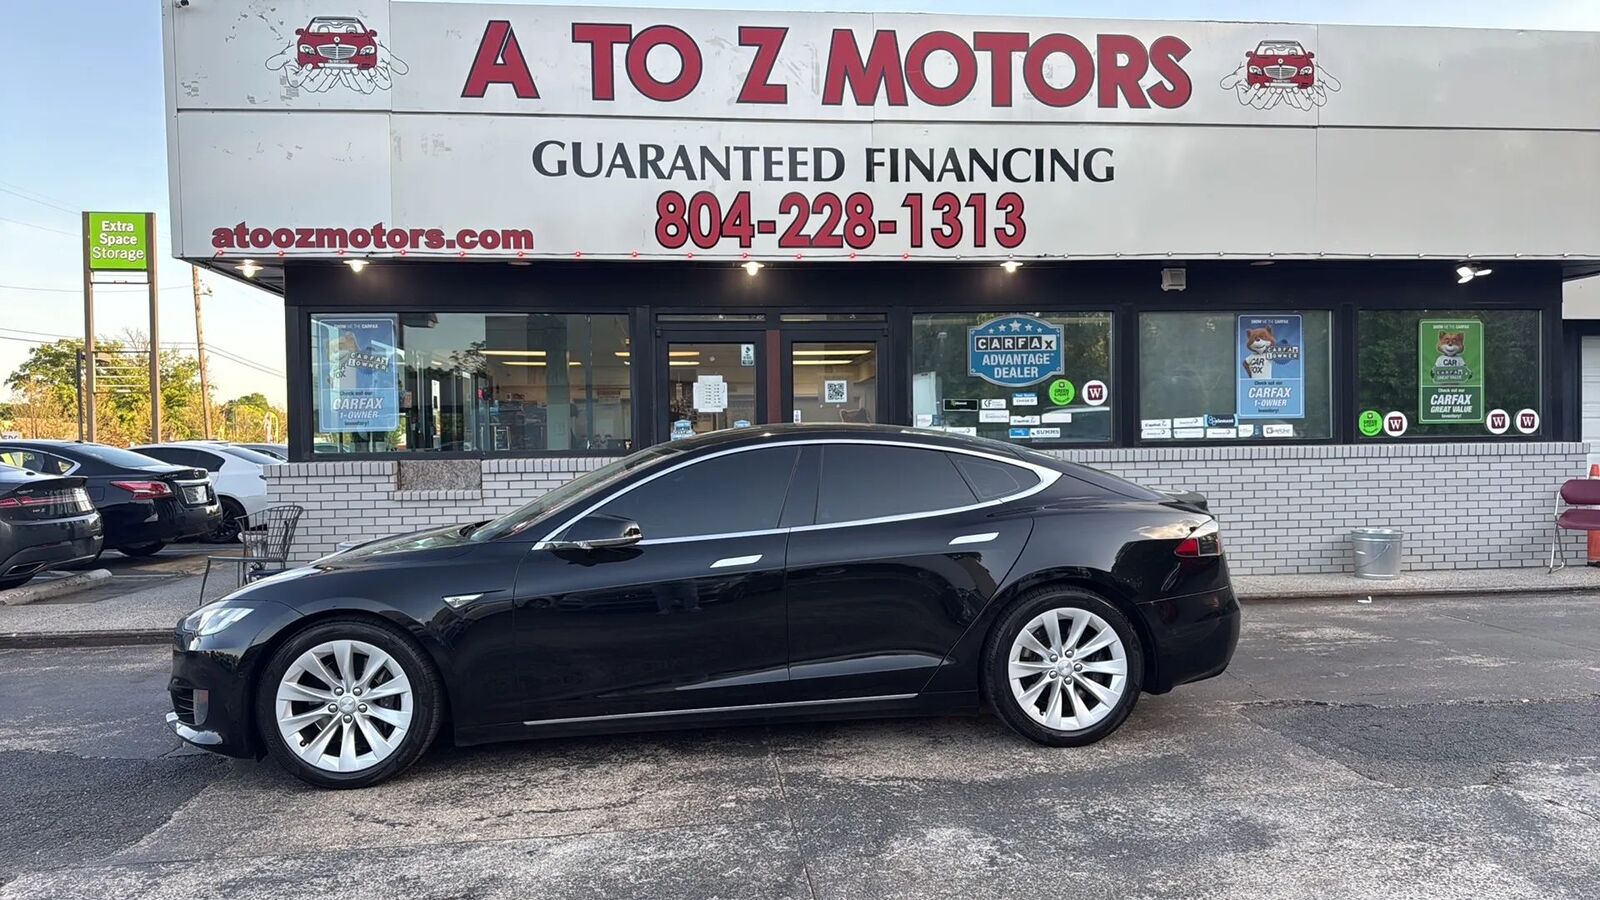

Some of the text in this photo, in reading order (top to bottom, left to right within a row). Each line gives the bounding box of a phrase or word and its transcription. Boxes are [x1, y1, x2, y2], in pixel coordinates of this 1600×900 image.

[460, 20, 1193, 109] A TO Z MOTORS
[532, 139, 1115, 183] GUARANTEED FINANCING
[101, 220, 134, 231] Extra
[654, 190, 1027, 249] 804-228-1313
[99, 232, 138, 246] Space
[211, 221, 535, 250] atoozmotors.com
[92, 246, 144, 261] Storage
[977, 336, 1055, 350] CARFAX
[982, 353, 1050, 366] ADVANTAGE
[994, 366, 1039, 378] DEALER
[1089, 387, 1101, 398] W
[1248, 388, 1291, 398] CARFAX
[333, 398, 383, 410] CARFAX
[1430, 394, 1472, 405] CARFAX
[340, 411, 379, 419] 1-OWNER
[1389, 419, 1402, 430] W
[1492, 416, 1505, 427] W
[1522, 416, 1534, 427] W
